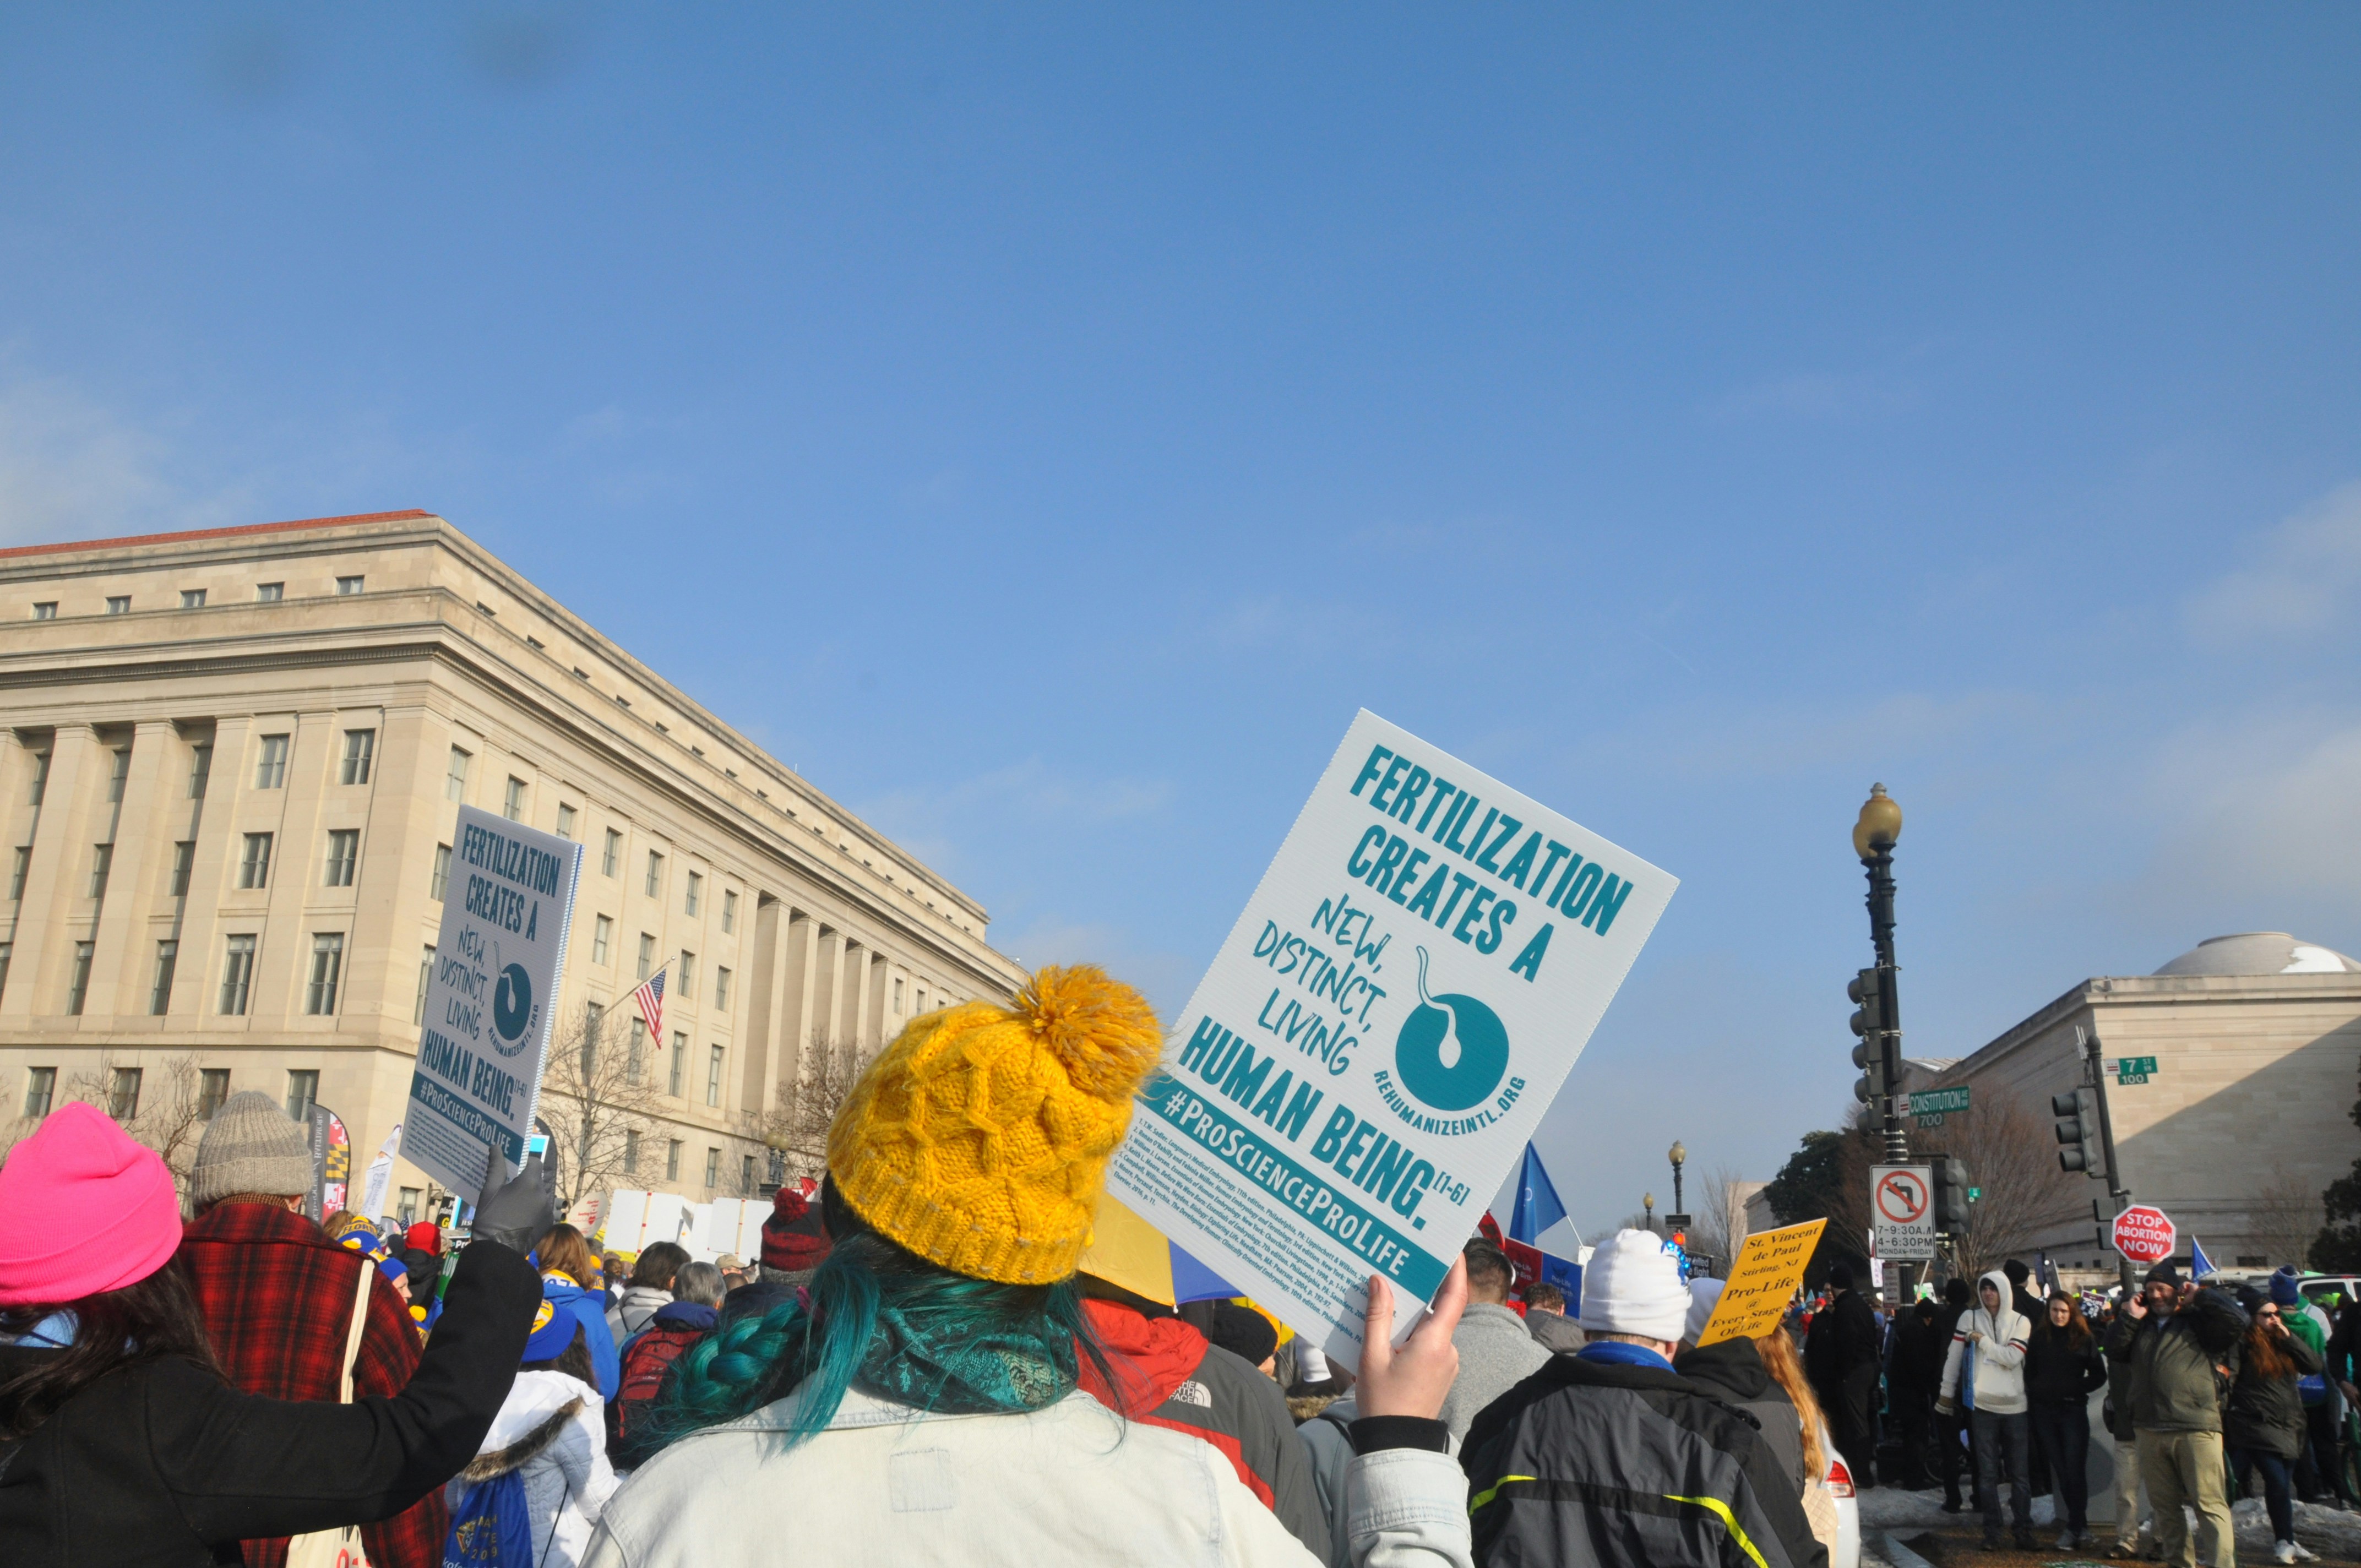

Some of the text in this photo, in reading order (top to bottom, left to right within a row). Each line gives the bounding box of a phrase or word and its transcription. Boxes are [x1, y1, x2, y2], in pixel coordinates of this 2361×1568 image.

[460, 823, 562, 898] FERTILIZATION
[1350, 744, 1633, 936] FERTILIZATION
[464, 873, 540, 941] CREATES A
[1348, 825, 1553, 982] CREATES A
[457, 922, 487, 968] NEW,
[1312, 894, 1391, 972] NEW,
[439, 955, 488, 1006] DISTINCT,
[1254, 921, 1386, 1032] DISTINCT,
[445, 997, 482, 1041] LIVING
[488, 1004, 539, 1059] REHUMANIZEINTL.ORG
[1258, 988, 1357, 1075] LIVING
[421, 1028, 473, 1091] HUMAN
[471, 1057, 515, 1121] BEING.
[2121, 1074, 2145, 1084] 100
[2126, 1059, 2136, 1072] 7
[1180, 1016, 1323, 1141] HUMAN
[1310, 1104, 1434, 1230] BEING.
[1374, 1071, 1525, 1135] REHUMANIZEINTL.ORG
[1910, 1091, 1961, 1113] CONSTITUTION
[1920, 1114, 1943, 1127] 700
[1112, 1170, 1133, 1189] Elsevier,
[1130, 1184, 1145, 1197] 2016,
[1149, 1196, 1157, 1206] 11.
[1143, 1121, 1154, 1131] T.W.
[1152, 1128, 1169, 1142] Sadler.
[1167, 1139, 1193, 1161] Langman's
[1191, 1155, 1210, 1172] Medical
[1207, 1168, 1237, 1193] Embryology,
[1236, 1188, 1248, 1199] 11th
[1247, 1195, 1267, 1212] edition.
[1264, 1208, 1298, 1236] Philadelphia,
[1297, 1231, 1307, 1240] PA:
[1304, 1237, 1334, 1262] Lippinchott
[1337, 1260, 1359, 1279] Wilkins,
[1122, 1154, 1146, 1175] Campbell,
[1144, 1170, 1172, 1194] Williamson,
[1169, 1189, 1191, 1208] Heyden.
[1188, 1202, 1210, 1221] Biology:
[1206, 1216, 1230, 1236] Exploring
[1228, 1231, 1241, 1243] Life.
[1238, 1239, 1264, 1261] Needham,
[1263, 1256, 1274, 1267] MA:
[1272, 1263, 1295, 1283] Pearson,
[1293, 1278, 1309, 1293] 2004,
[1313, 1293, 1332, 1309] 192-97.
[1128, 1146, 1141, 1158] Keith
[1145, 1158, 1162, 1173] Moore.
[1160, 1169, 1177, 1184] Before
[1175, 1180, 1184, 1189] We
[1182, 1185, 1195, 1197] Were
[1193, 1193, 1207, 1206] Born:
[1206, 1202, 1229, 1222] Essentials
[1227, 1218, 1236, 1226] of
[1232, 1222, 1263, 1248] Embryology,
[1261, 1242, 1271, 1253] 7th
[1270, 1249, 1291, 1266] edition.
[1288, 1262, 1322, 1291] Philadelphia,
[1321, 1286, 1331, 1295] PA:
[1329, 1292, 1355, 1314] Saunders,
[1354, 1309, 1367, 1322] 200
[1133, 1137, 1151, 1153] William
[1154, 1153, 1172, 1168] Larsen.
[1171, 1164, 1194, 1184] Essentials
[1192, 1180, 1199, 1188] of
[1197, 1184, 1215, 1199] Human
[1212, 1195, 1243, 1221] Embryology.
[1241, 1216, 1254, 1227] New
[1252, 1223, 1265, 1235] York:
[1264, 1232, 1287, 1251] Churchill
[1285, 1248, 1316, 1274] Livingstone,
[1314, 1269, 1330, 1283] 1998,
[1334, 1283, 1348, 1295] 1-14.
[1138, 1129, 1154, 1143] Ronan
[1151, 1140, 1173, 1159] O'Rahilly
[1172, 1153, 1183, 1164] and
[1181, 1160, 1199, 1176] Fabiola
[1215, 1184, 1232, 1200] Human
[1230, 1196, 1259, 1221] Embryology
[1258, 1215, 1269, 1226] and
[1266, 1222, 1294, 1245] Teratology,
[1292, 1240, 1303, 1250] 3rd
[1301, 1246, 1322, 1264] edition.
[1320, 1260, 1333, 1272] New
[1332, 1268, 1346, 1281] York:
[1343, 1277, 1370, 1300] Wiley-Lis
[2116, 1226, 2171, 1243] ABORTION
[2126, 1213, 2164, 1228] STOP
[1117, 1162, 1135, 1178] Moore,
[1133, 1174, 1155, 1193] Persaud,
[1152, 1188, 1172, 1205] Torchia.
[1171, 1201, 1180, 1211] The
[1178, 1207, 1205, 1230] Developing
[1203, 1225, 1223, 1242] Human:
[1220, 1238, 1243, 1258] Clinically
[1242, 1253, 1263, 1271] Oriented
[1260, 1267, 1291, 1293] Embryology,
[1290, 1288, 1303, 1300] 10th
[1301, 1297, 1323, 1315] edition.
[1320, 1311, 1355, 1340] Philadelphia,
[1748, 1227, 1819, 1249] St. Vincent
[1753, 1243, 1802, 1262] de Paul
[1878, 1238, 1933, 1246] 4-6:30PM
[2123, 1239, 2163, 1255] NOW
[1727, 1277, 1794, 1301] Pro-Life
[1740, 1259, 1799, 1278] Stirling, NJ
[1711, 1306, 1782, 1328] Every Stage
[1739, 1321, 1762, 1332] Life
[1747, 1299, 1761, 1310] @
[1182, 1380, 1195, 1388] HE
